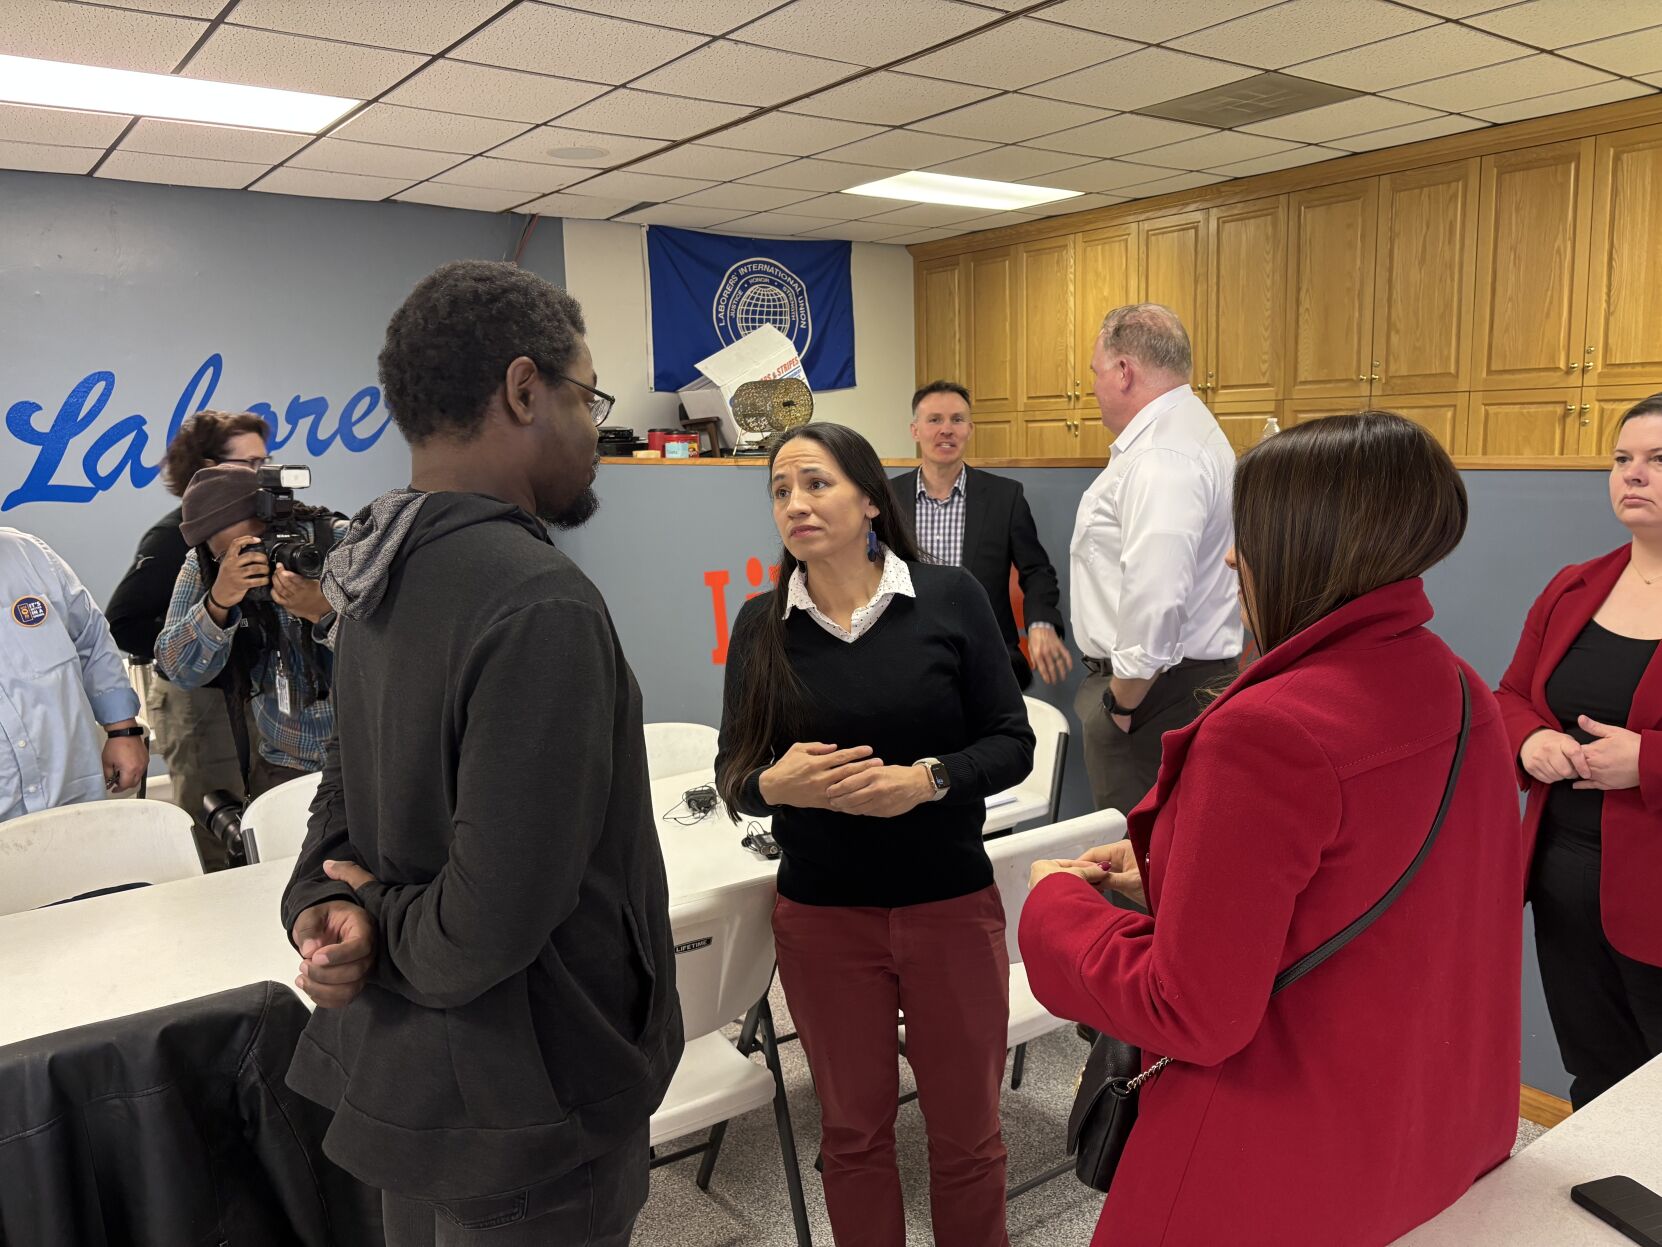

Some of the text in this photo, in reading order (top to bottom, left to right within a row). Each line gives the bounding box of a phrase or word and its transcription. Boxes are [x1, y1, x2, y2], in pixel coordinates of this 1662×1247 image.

[718, 263, 807, 328] LABORERS' INTERNATIONAL UNION
[729, 289, 744, 318] JUSTICE
[776, 356, 799, 376] STRIPES
[676, 940, 707, 952] LIFETIME
